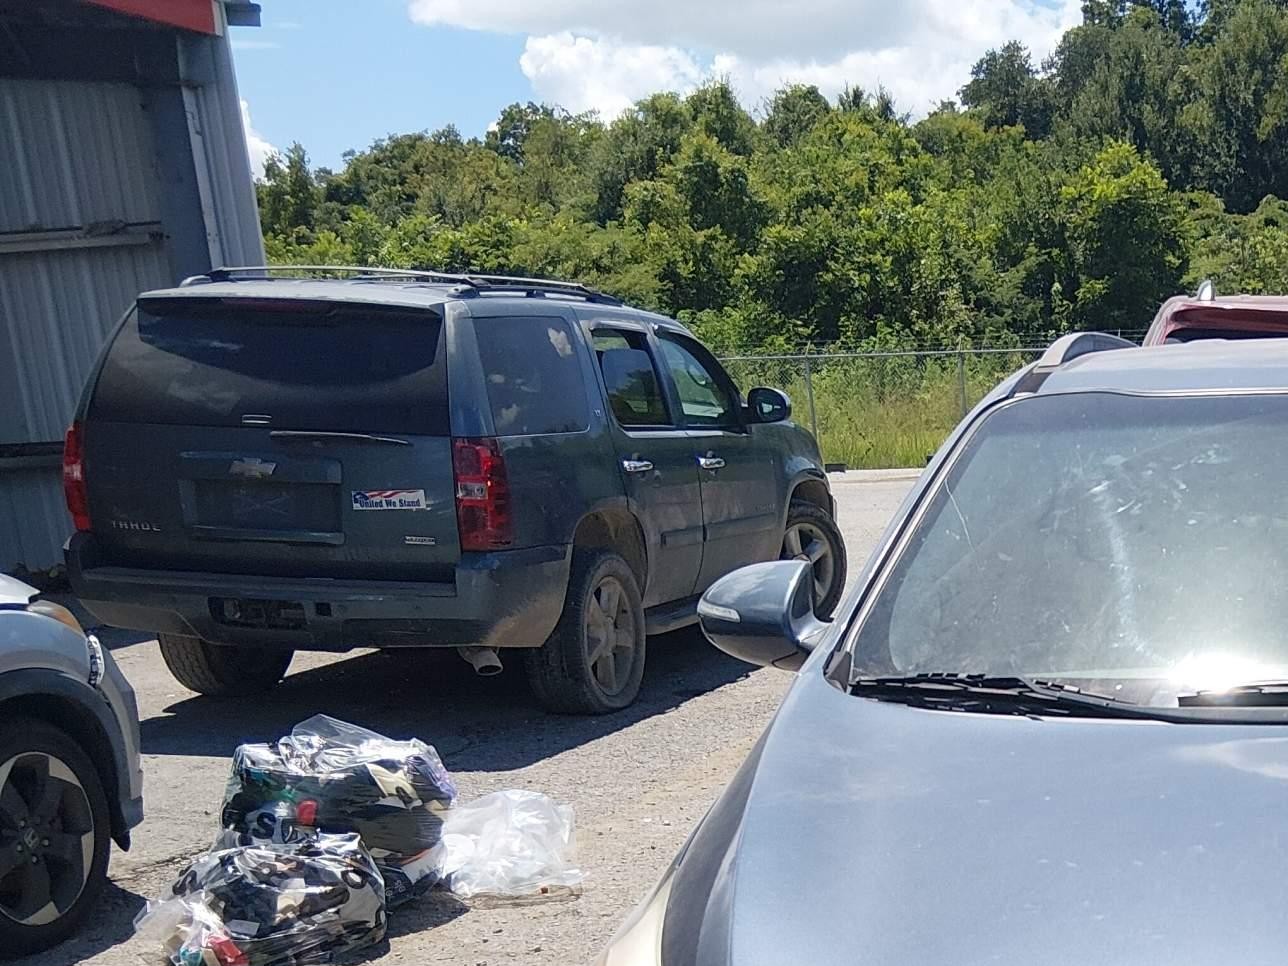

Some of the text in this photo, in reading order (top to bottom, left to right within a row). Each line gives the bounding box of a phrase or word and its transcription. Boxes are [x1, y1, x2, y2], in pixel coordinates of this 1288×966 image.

[360, 498, 421, 509] United We Stand
